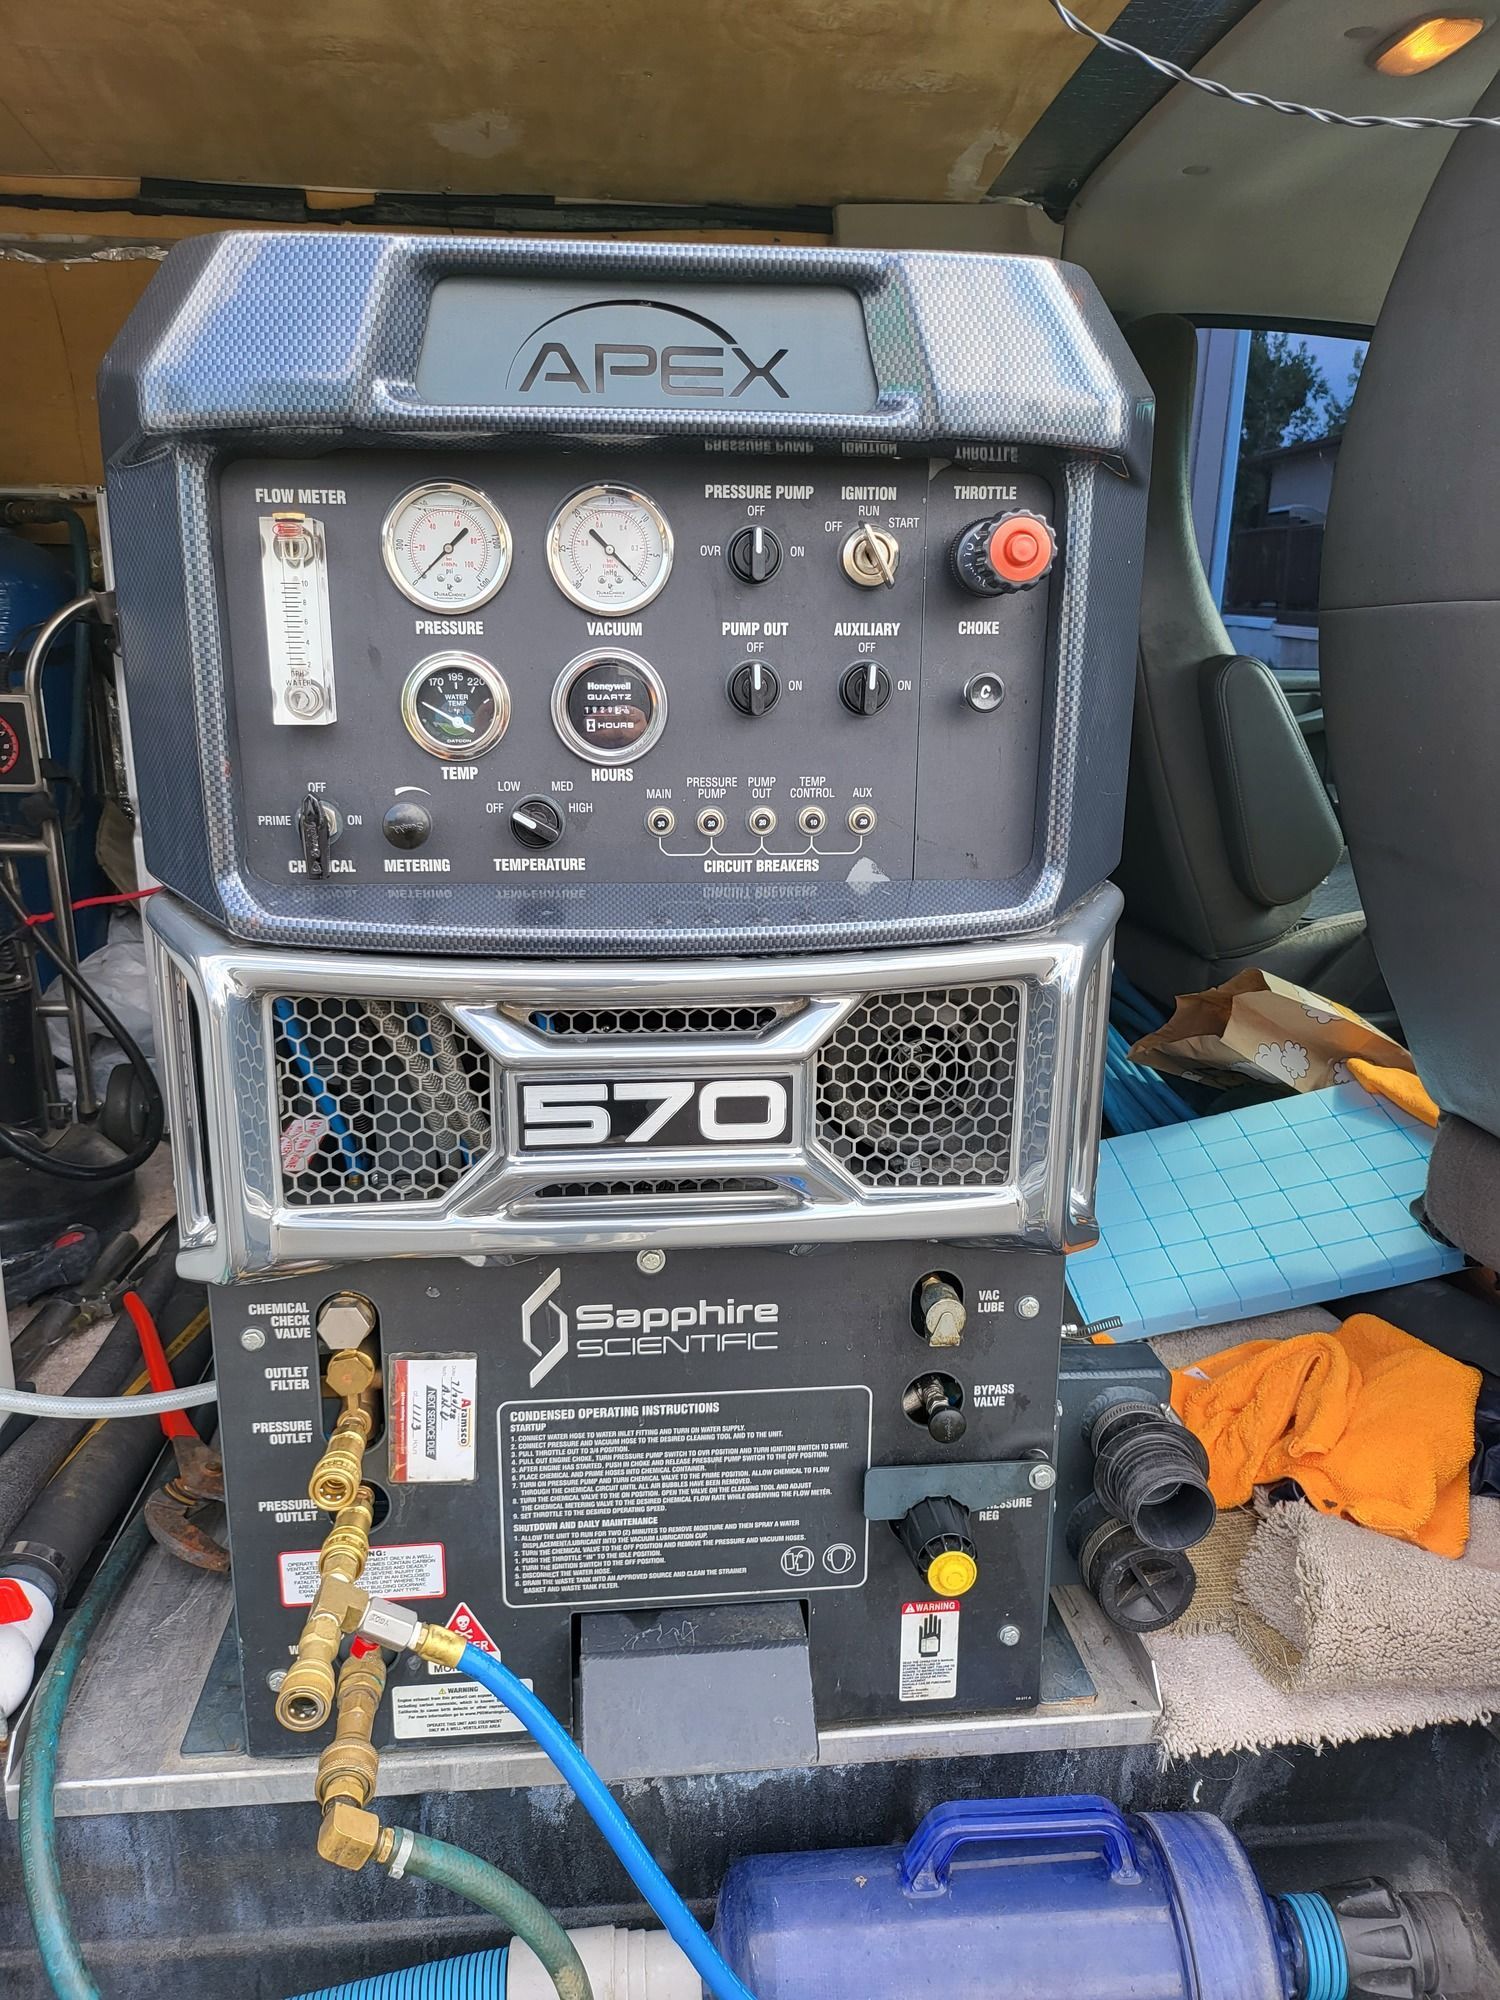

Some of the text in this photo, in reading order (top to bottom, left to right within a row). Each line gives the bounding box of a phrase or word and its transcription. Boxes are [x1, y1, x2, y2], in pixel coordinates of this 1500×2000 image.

[518, 343, 790, 398] APEX
[256, 489, 346, 504] FLOW METER
[705, 485, 813, 499] PRESSURE PUMP
[842, 487, 896, 500] IGNITION
[954, 486, 1016, 499] THROTTLE
[748, 506, 765, 516] OFF
[859, 506, 879, 516] RUN
[825, 522, 842, 531] OFF
[889, 518, 917, 528] START
[701, 546, 720, 556] OVR
[791, 546, 804, 556] ON
[416, 621, 483, 634] PRESSURE
[587, 622, 642, 635] VACUUM
[723, 622, 788, 635] PUMP OUT
[834, 623, 900, 635] AUXILIARY
[959, 622, 999, 634] CHOKE
[747, 642, 763, 652] OFF
[859, 643, 875, 652] OFF
[429, 678, 444, 686] 170
[448, 673, 464, 681] 195
[467, 678, 485, 686] 220
[587, 682, 631, 691] Honeywell
[789, 681, 802, 690] ON
[898, 681, 911, 690] ON
[441, 767, 478, 779] TEMP
[592, 769, 633, 781] HOURS
[498, 781, 520, 791] LOW
[552, 781, 573, 791] MED
[687, 777, 737, 787] PRESSURE
[748, 777, 776, 789] PUMP
[802, 777, 825, 786] TEMP
[307, 782, 327, 793] OFF
[752, 788, 771, 798] OUT
[790, 788, 831, 798] CONTROL
[853, 788, 872, 797] AUX
[647, 789, 671, 798] MAIN
[699, 789, 726, 798] PUMP
[486, 803, 503, 813] OFF
[569, 803, 592, 812] HIGH
[259, 816, 290, 825] PRIME
[348, 815, 362, 825] ON
[859, 818, 868, 826] 20
[288, 860, 356, 873] CHICAL
[385, 859, 450, 872] METERING
[494, 858, 585, 871] TEMPERATURE
[704, 859, 819, 872] CIRCUIT BREAKERS
[523, 1080, 787, 1146] 570
[978, 1290, 1000, 1300] VAC
[248, 1303, 310, 1315] CHEMICAL
[978, 1302, 1005, 1312] LUBE
[271, 1315, 311, 1327] CHECK
[576, 1298, 779, 1333] Sapphire
[274, 1327, 311, 1339] VALVE
[577, 1332, 778, 1358] SCIENTIFIC
[264, 1366, 308, 1379] OUTLET
[270, 1379, 310, 1391] FILTER
[974, 1384, 1014, 1395] BYPASS
[974, 1396, 1005, 1407] VALVE
[509, 1401, 719, 1422] CONDENSED OPERATING INSTRUCTIONS
[427, 1390, 436, 1456] NEXT SERVICE DUE
[461, 1398, 472, 1444] Aramsco
[252, 1420, 312, 1434] PRESSURE
[510, 1422, 546, 1432] STARTUP
[269, 1432, 313, 1445] OUTLET
[517, 1434, 546, 1442] CONNECT
[547, 1433, 568, 1441] WATER
[569, 1432, 585, 1440] HOSE
[595, 1430, 616, 1438] WATER
[635, 1428, 658, 1436] FITTING
[673, 1427, 689, 1435] TURN
[722, 1424, 745, 1432] SUPPLY.
[518, 1441, 546, 1450] CONNECT
[547, 1440, 579, 1449] PRESSURE
[579, 1439, 593, 1447] AND
[593, 1438, 619, 1446] VACUUM
[620, 1437, 636, 1445] HOSE
[638, 1436, 646, 1444] TO
[647, 1436, 658, 1444] THE
[659, 1435, 685, 1443] DESIRED
[686, 1433, 715, 1442] CLEANING
[716, 1432, 731, 1440] TOOL
[732, 1432, 745, 1440] AND
[746, 1431, 754, 1439] TO
[767, 1430, 783, 1438] UNIT.
[258, 1499, 317, 1512] PRESSURE
[275, 1510, 318, 1523] OUTLET
[979, 1511, 1000, 1521] REG
[513, 1516, 658, 1532] SHUTDOWN AND DAILY MAINTENANCE
[916, 1602, 955, 1612] WARNING
[448, 1686, 479, 1694] WARNING
